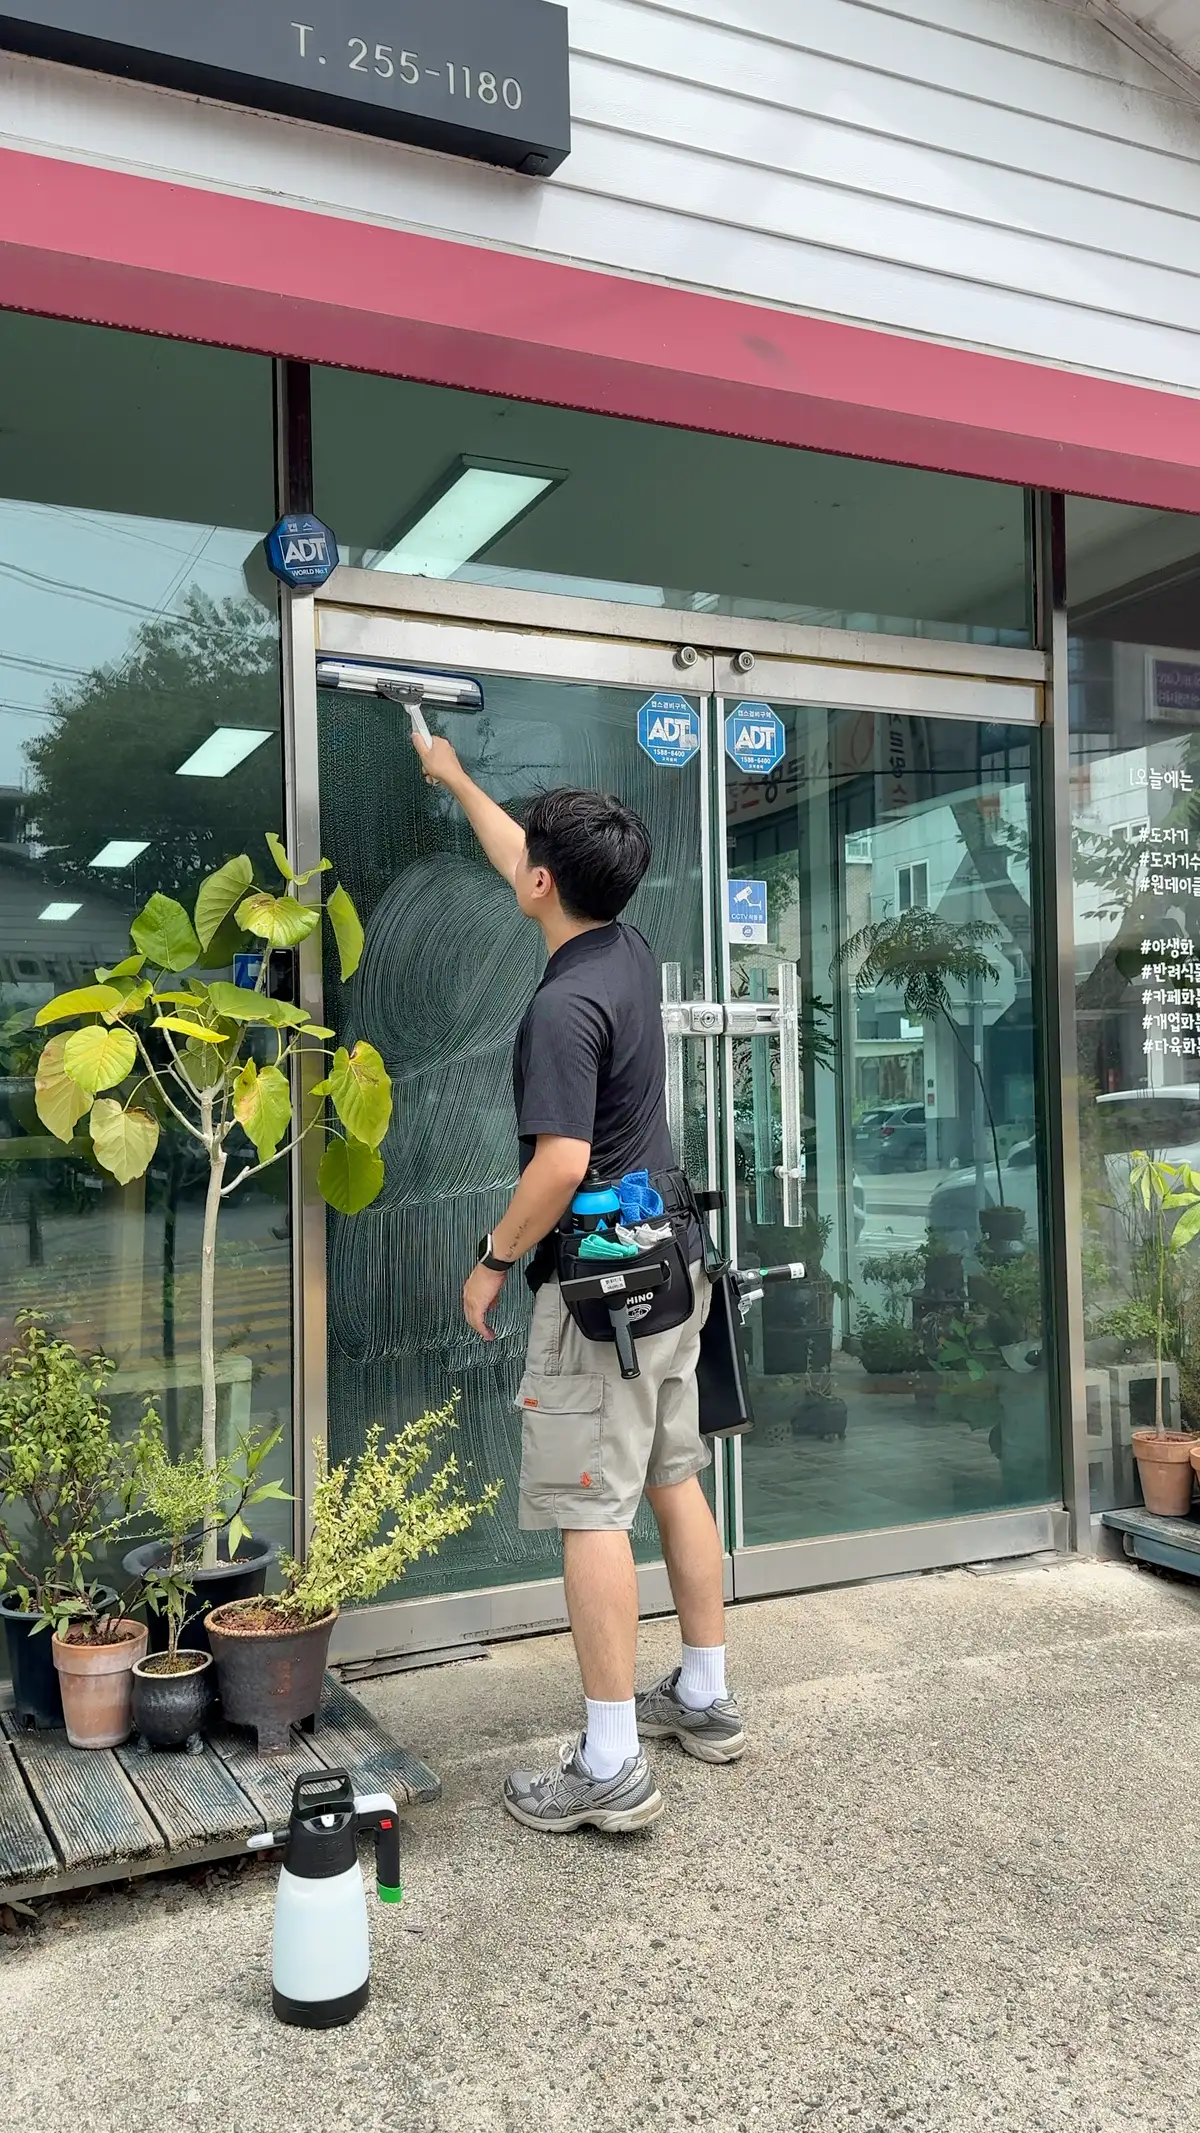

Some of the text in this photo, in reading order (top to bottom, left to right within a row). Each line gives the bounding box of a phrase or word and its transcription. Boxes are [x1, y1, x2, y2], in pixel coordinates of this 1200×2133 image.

[291, 21, 522, 110] T. 255-1180
[285, 538, 325, 563] ADT
[291, 569, 314, 577] WORLD
[648, 716, 690, 743] ADT
[735, 725, 776, 750] ADT
[653, 749, 686, 757] 1588-6400
[741, 756, 771, 764] 1588-6400
[1129, 767, 1194, 791] [오늘에는
[1138, 827, 1189, 845] #도자기
[1138, 851, 1200, 871] #도자기수
[1140, 937, 1195, 959] #야생화
[1142, 1036, 1200, 1057] #다육화
